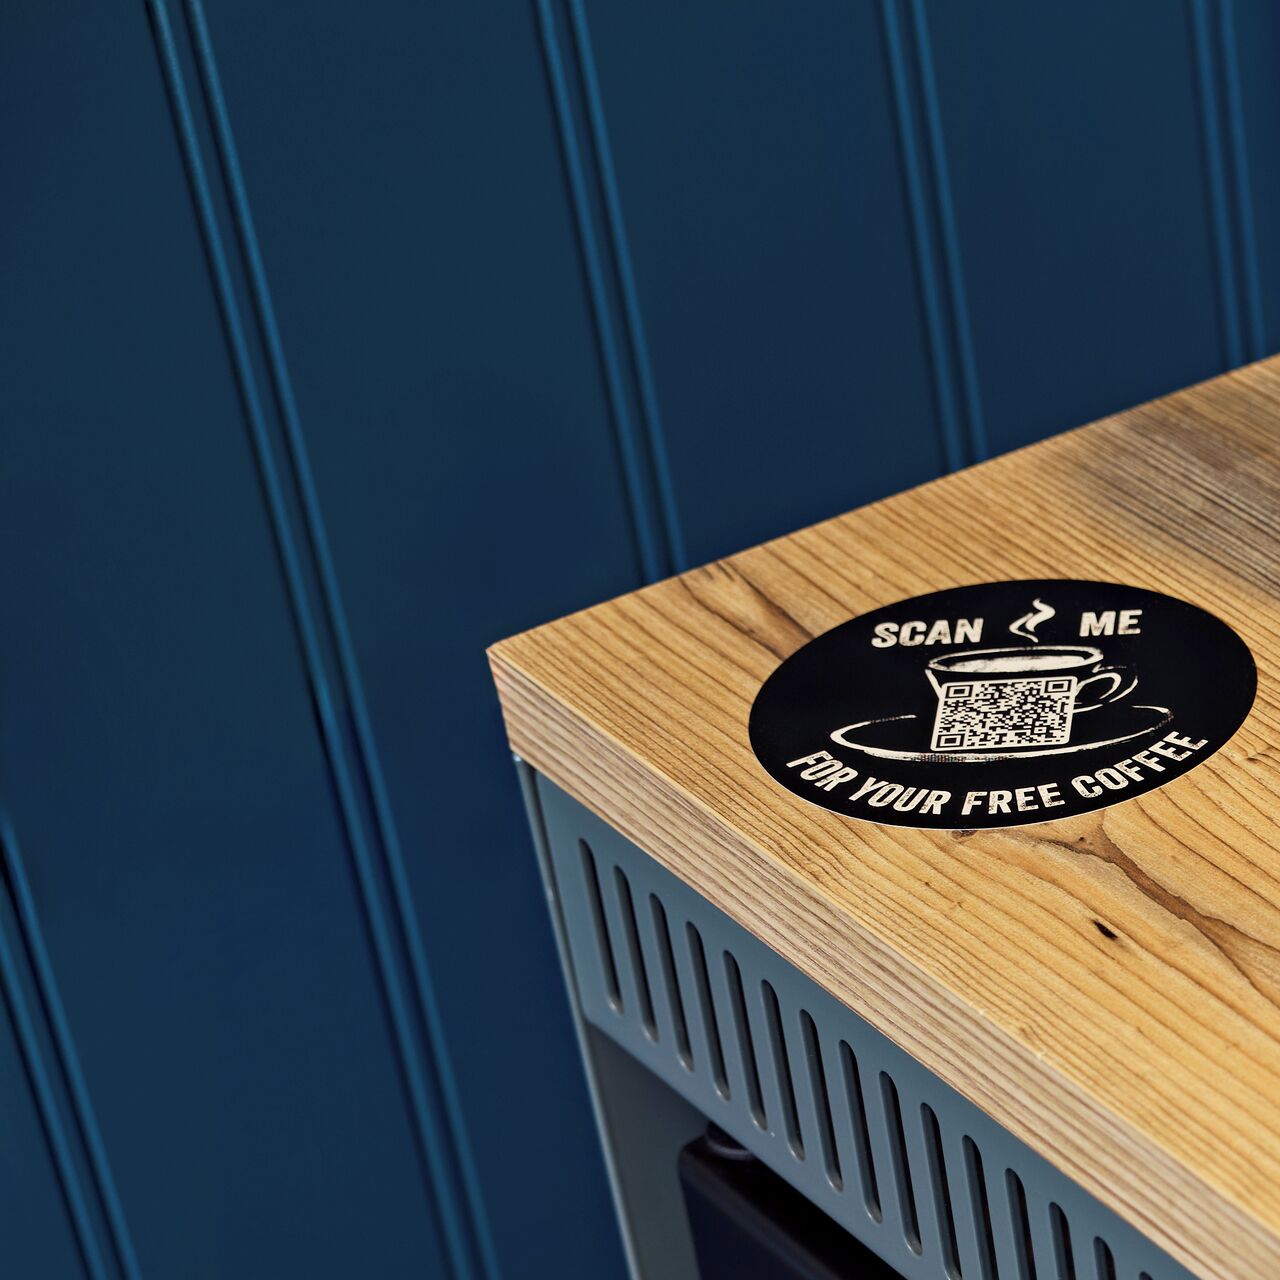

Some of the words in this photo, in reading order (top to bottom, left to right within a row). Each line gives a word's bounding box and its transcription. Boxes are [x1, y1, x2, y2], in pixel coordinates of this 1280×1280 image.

[871, 617, 984, 648] SCAN
[1079, 609, 1142, 637] ME
[786, 750, 858, 791] FOR
[848, 777, 952, 815] YOUR
[961, 782, 1066, 815] FREE
[1071, 731, 1209, 799] COFFEE
